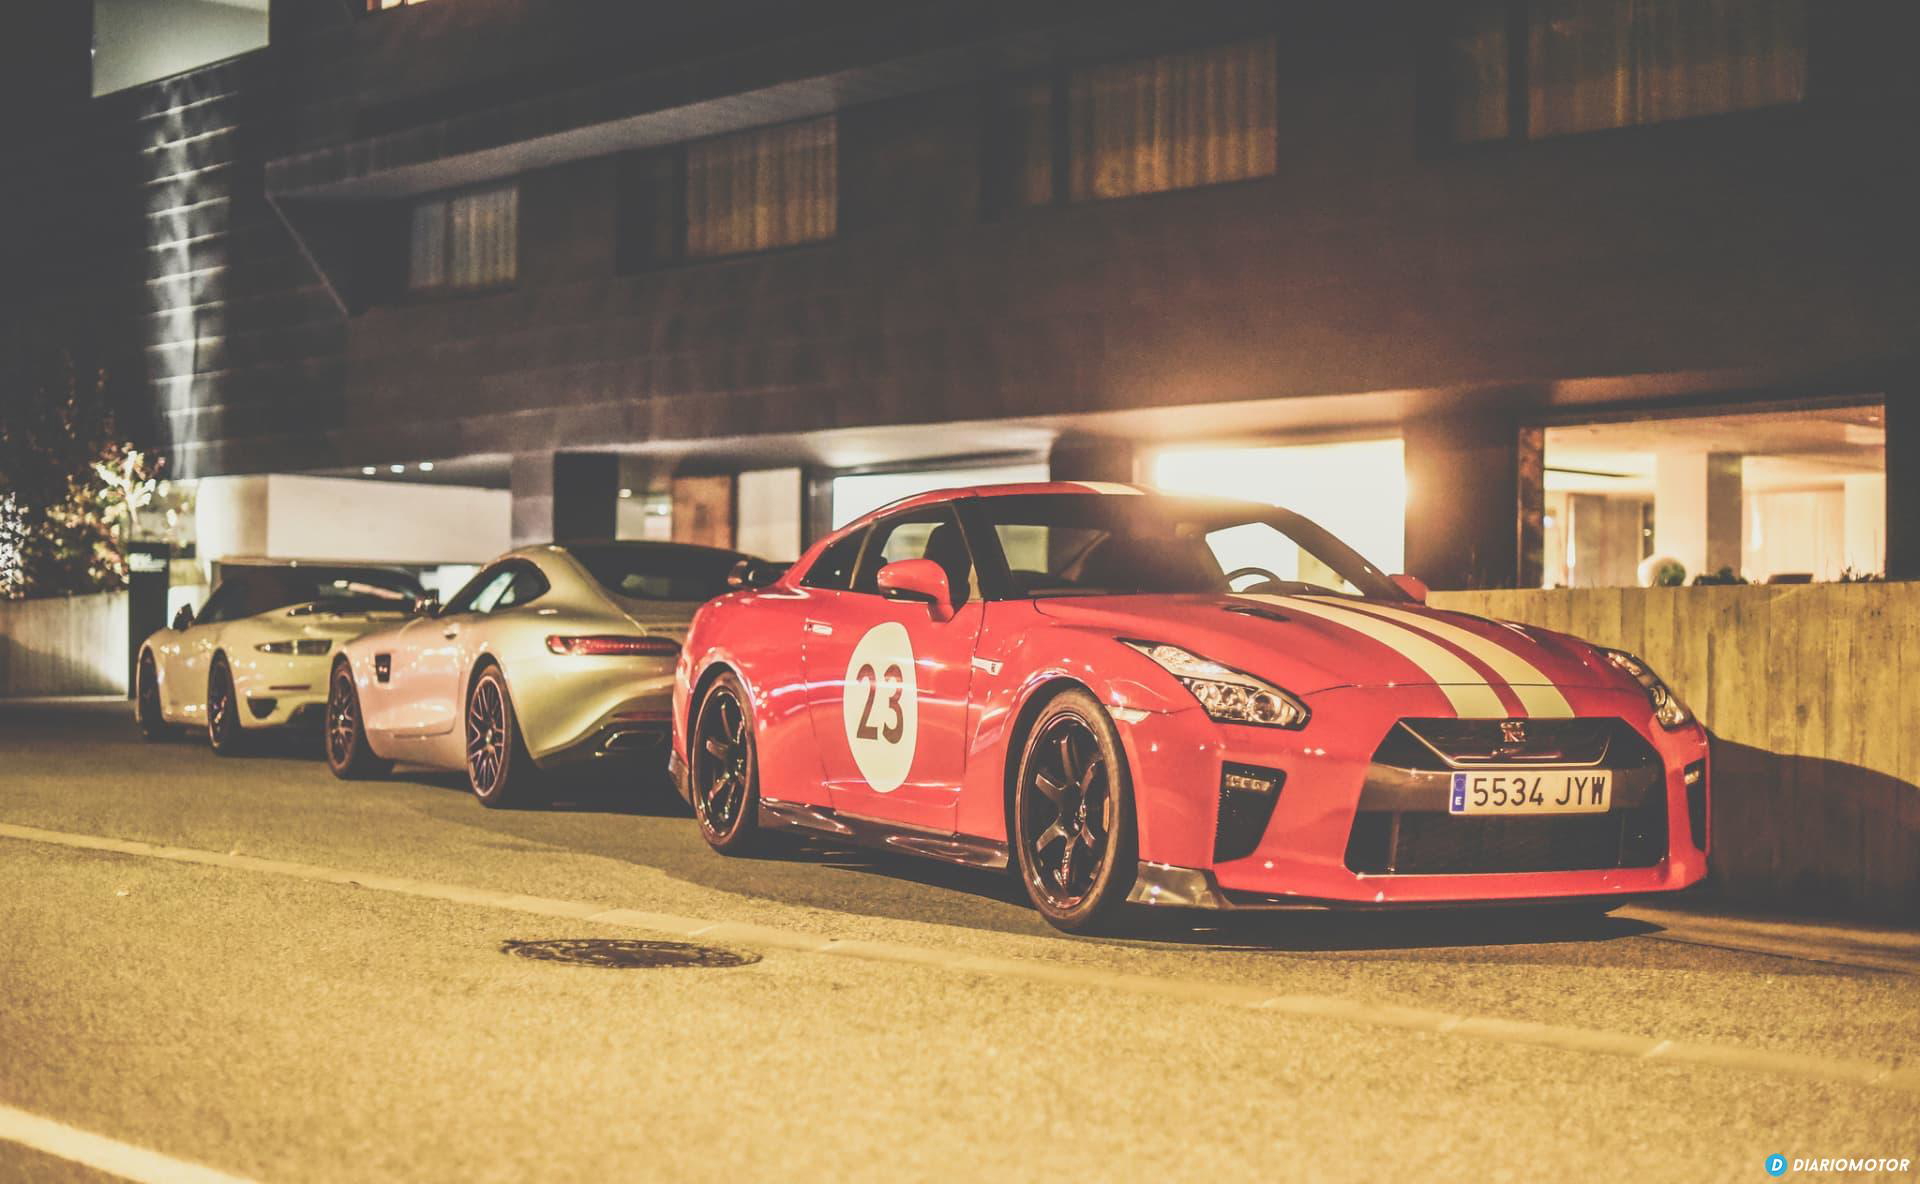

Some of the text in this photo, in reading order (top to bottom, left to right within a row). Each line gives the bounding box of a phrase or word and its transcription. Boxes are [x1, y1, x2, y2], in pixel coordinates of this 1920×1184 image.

[856, 663, 904, 744] 23
[1455, 796, 1462, 806] E
[1473, 776, 1606, 807] 5534 JYW
